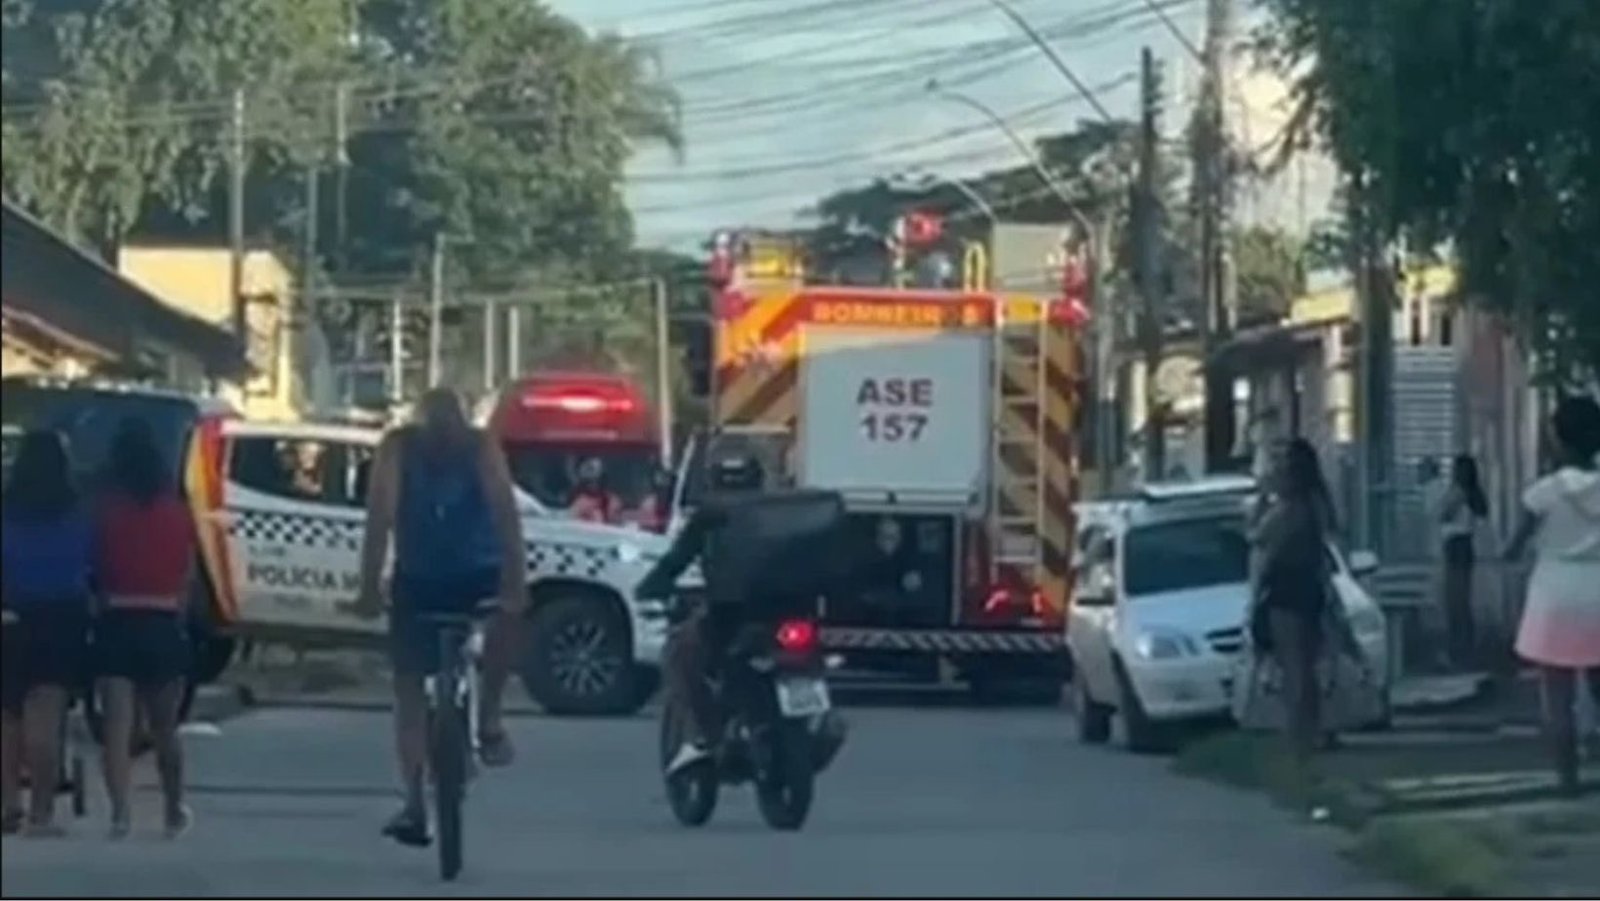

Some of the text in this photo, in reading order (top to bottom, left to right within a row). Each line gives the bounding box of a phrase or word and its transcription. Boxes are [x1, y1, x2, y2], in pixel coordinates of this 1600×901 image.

[813, 301, 979, 326] BOMBEIRS
[857, 378, 934, 407] ASE
[861, 414, 928, 442] 157
